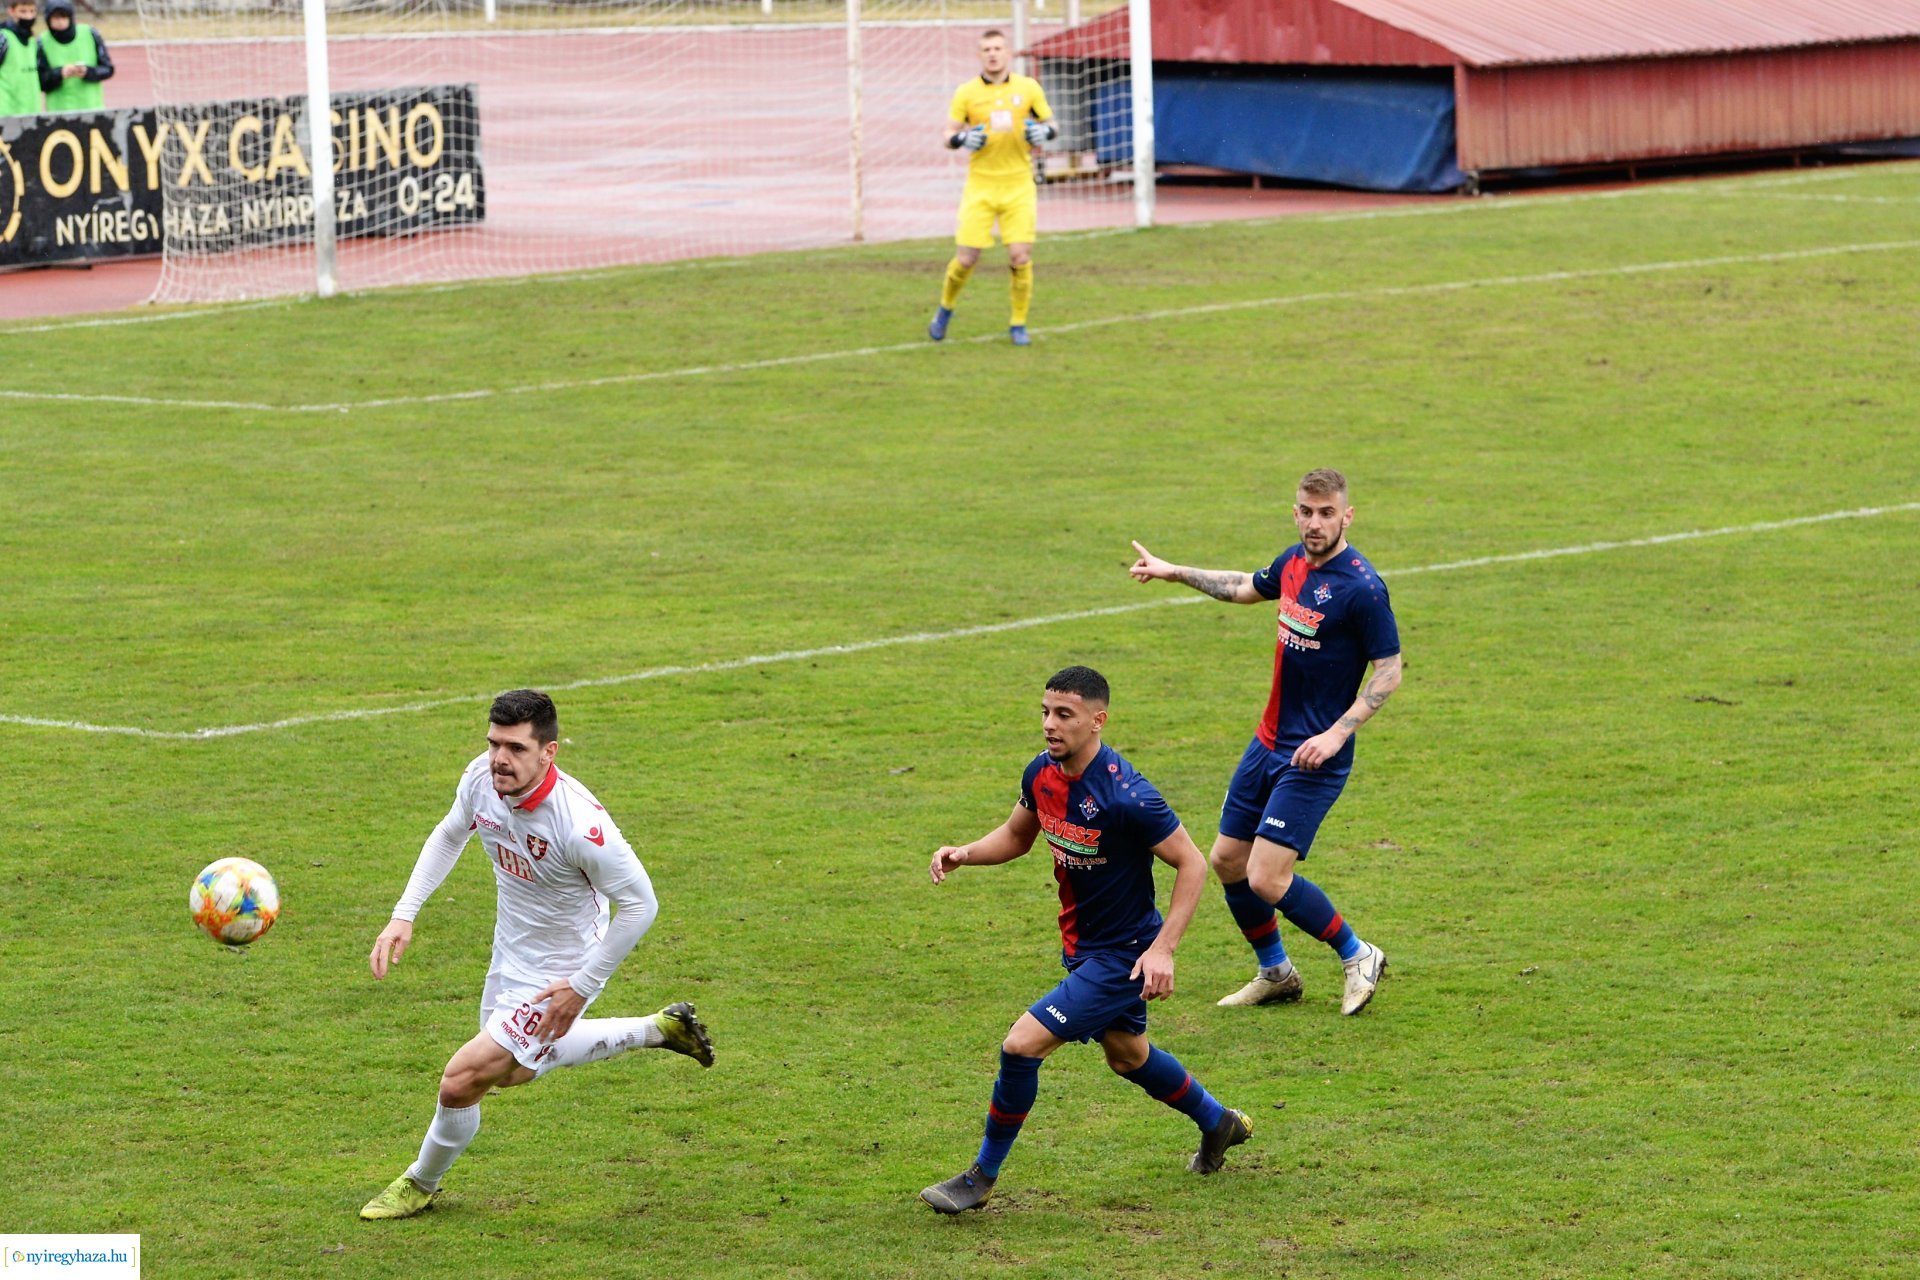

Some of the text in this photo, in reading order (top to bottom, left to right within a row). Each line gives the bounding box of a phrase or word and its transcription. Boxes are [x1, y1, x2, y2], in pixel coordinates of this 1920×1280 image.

[39, 120, 215, 198] ONYX
[242, 189, 368, 232] NYÍRPZA
[399, 173, 476, 216] 0-24
[1265, 816, 1286, 829] JAKO
[511, 1003, 542, 1036] 26
[1046, 1005, 1067, 1023] JAKO
[501, 1021, 529, 1049] macron
